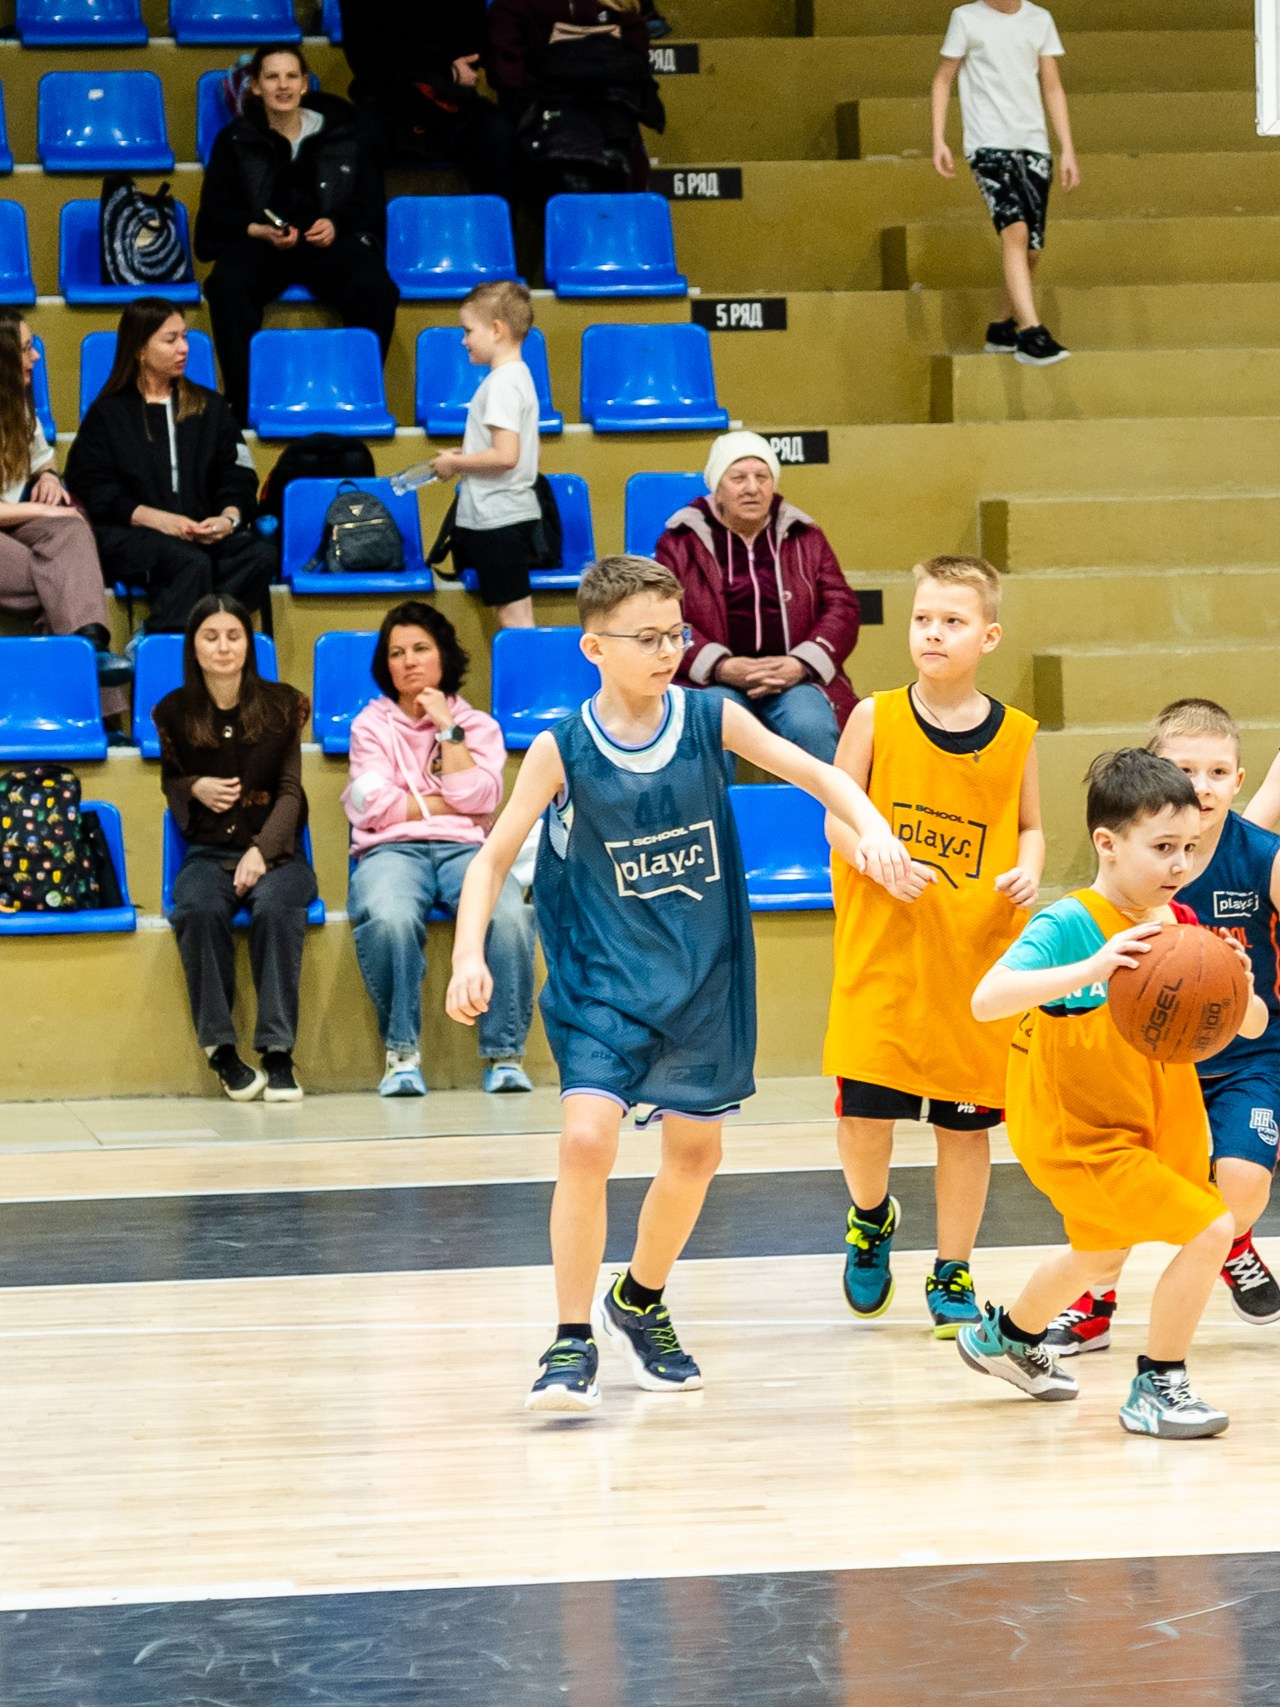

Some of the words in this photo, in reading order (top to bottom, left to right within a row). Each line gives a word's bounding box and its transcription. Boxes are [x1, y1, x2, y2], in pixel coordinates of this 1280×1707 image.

[673, 173, 685, 196] 6
[687, 172, 720, 197] РЯД
[715, 303, 728, 328] 5
[730, 302, 764, 329] РЯД
[915, 804, 965, 824] SCHOOL
[632, 827, 689, 847] SCHOOL
[898, 820, 972, 859] plays.
[1141, 976, 1184, 1053] JÖGEL
